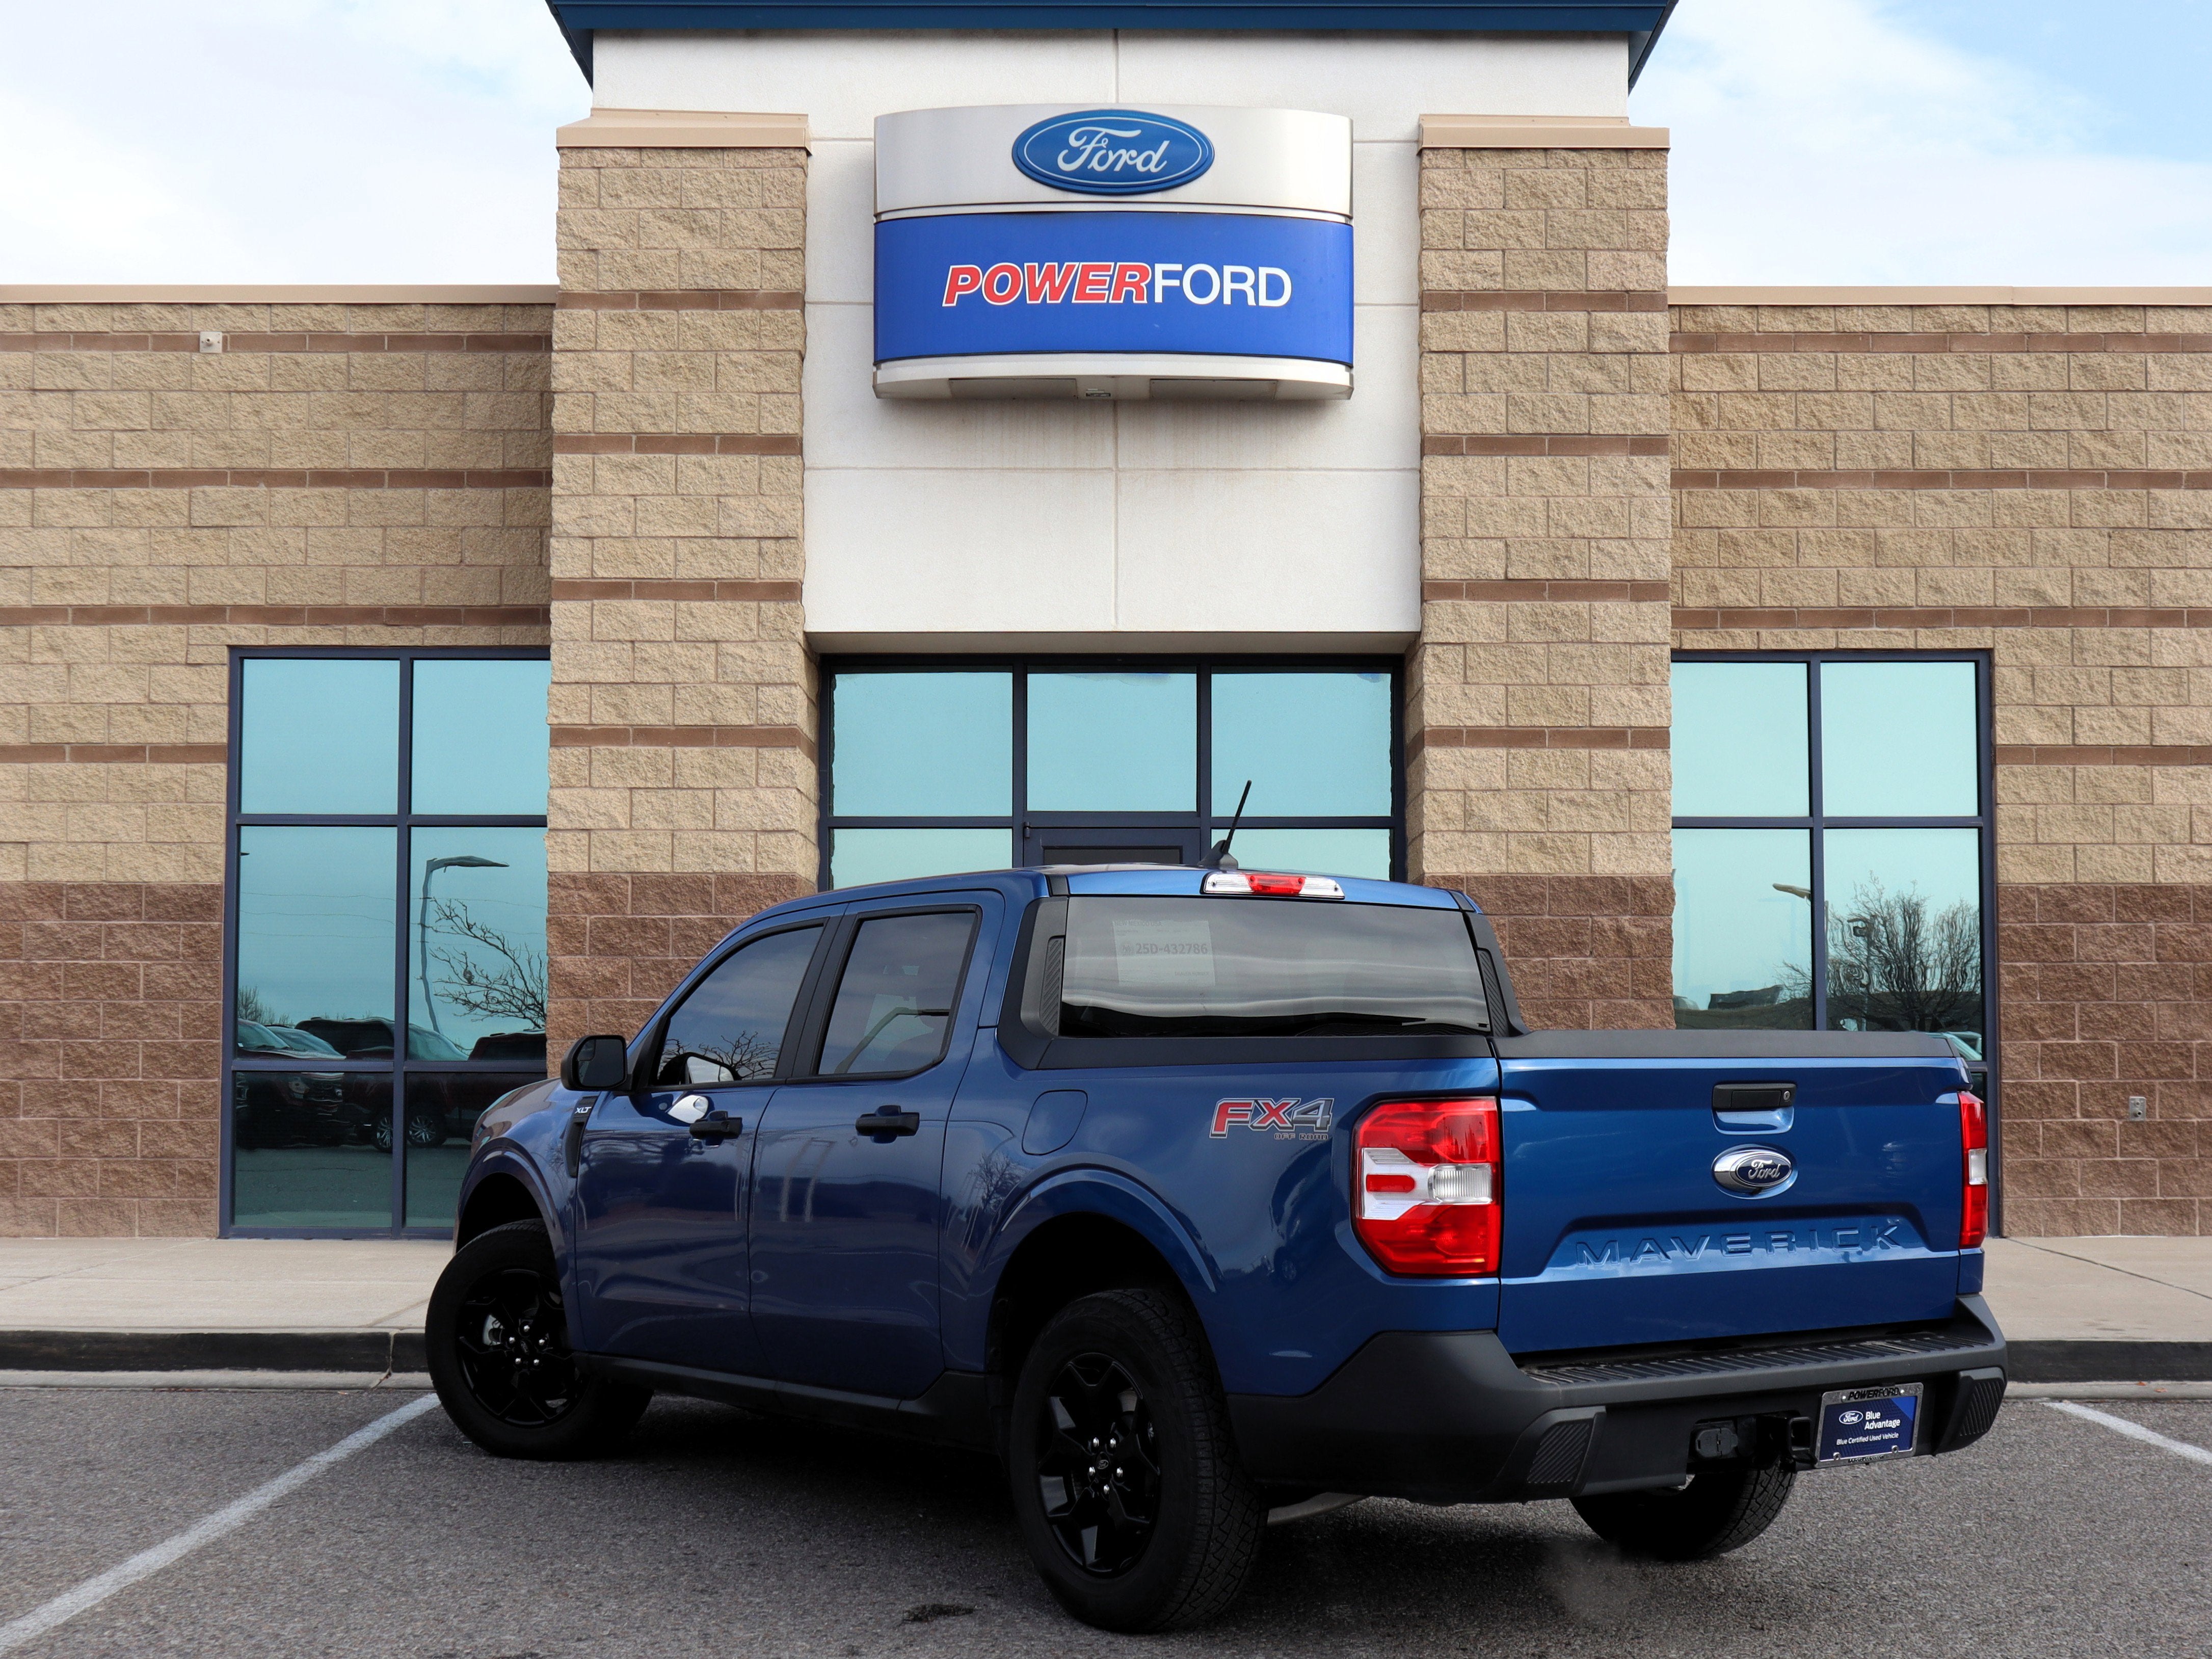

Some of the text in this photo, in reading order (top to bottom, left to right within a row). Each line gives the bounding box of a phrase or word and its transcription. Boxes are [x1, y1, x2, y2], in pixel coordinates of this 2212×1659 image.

[1057, 126, 1168, 173] Ford
[942, 261, 1293, 308] POWERFORD
[1135, 942, 1208, 955] 25D-432786
[1209, 1097, 1335, 1139] FX4
[1299, 1133, 1328, 1141] ROAD
[1747, 1158, 1780, 1182] Ford
[1575, 1224, 1900, 1268] MAVERICK
[1848, 1387, 1900, 1401] POWERFORD
[1843, 1412, 1858, 1423] Ford
[1865, 1411, 1881, 1420] Blue
[1864, 1419, 1901, 1430] Advantage
[1848, 1435, 1869, 1444] Certified
